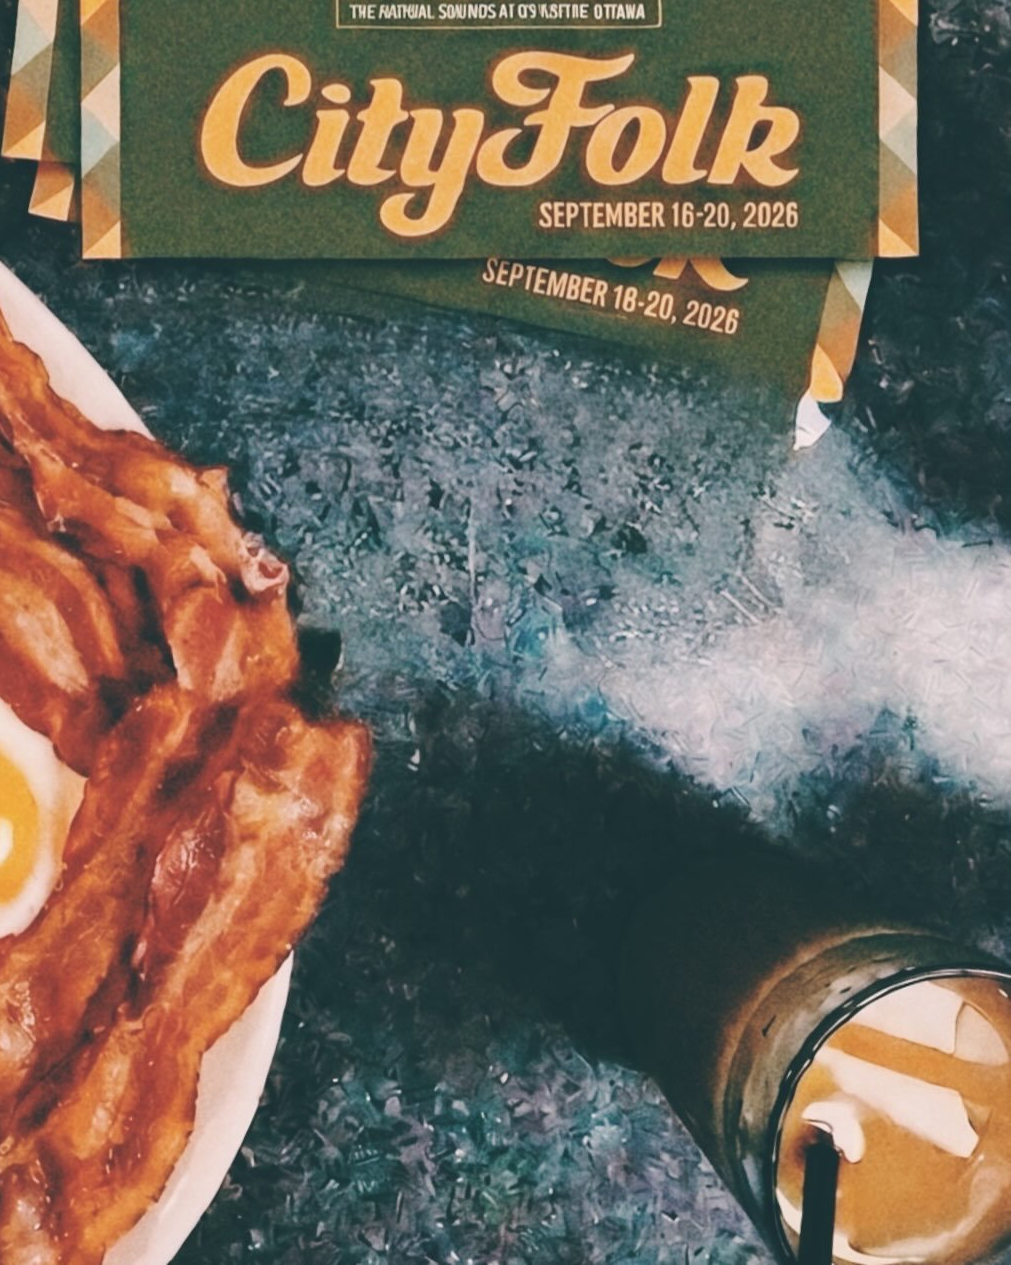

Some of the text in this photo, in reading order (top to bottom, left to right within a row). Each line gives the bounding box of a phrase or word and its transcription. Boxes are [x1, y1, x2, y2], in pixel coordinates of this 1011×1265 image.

[593, 3, 646, 20] OTTAWA
[538, 201, 800, 231] SEPTEMBER 16-20, 2026
[482, 257, 608, 308] SEPTEMBER
[682, 299, 740, 335] 2026
